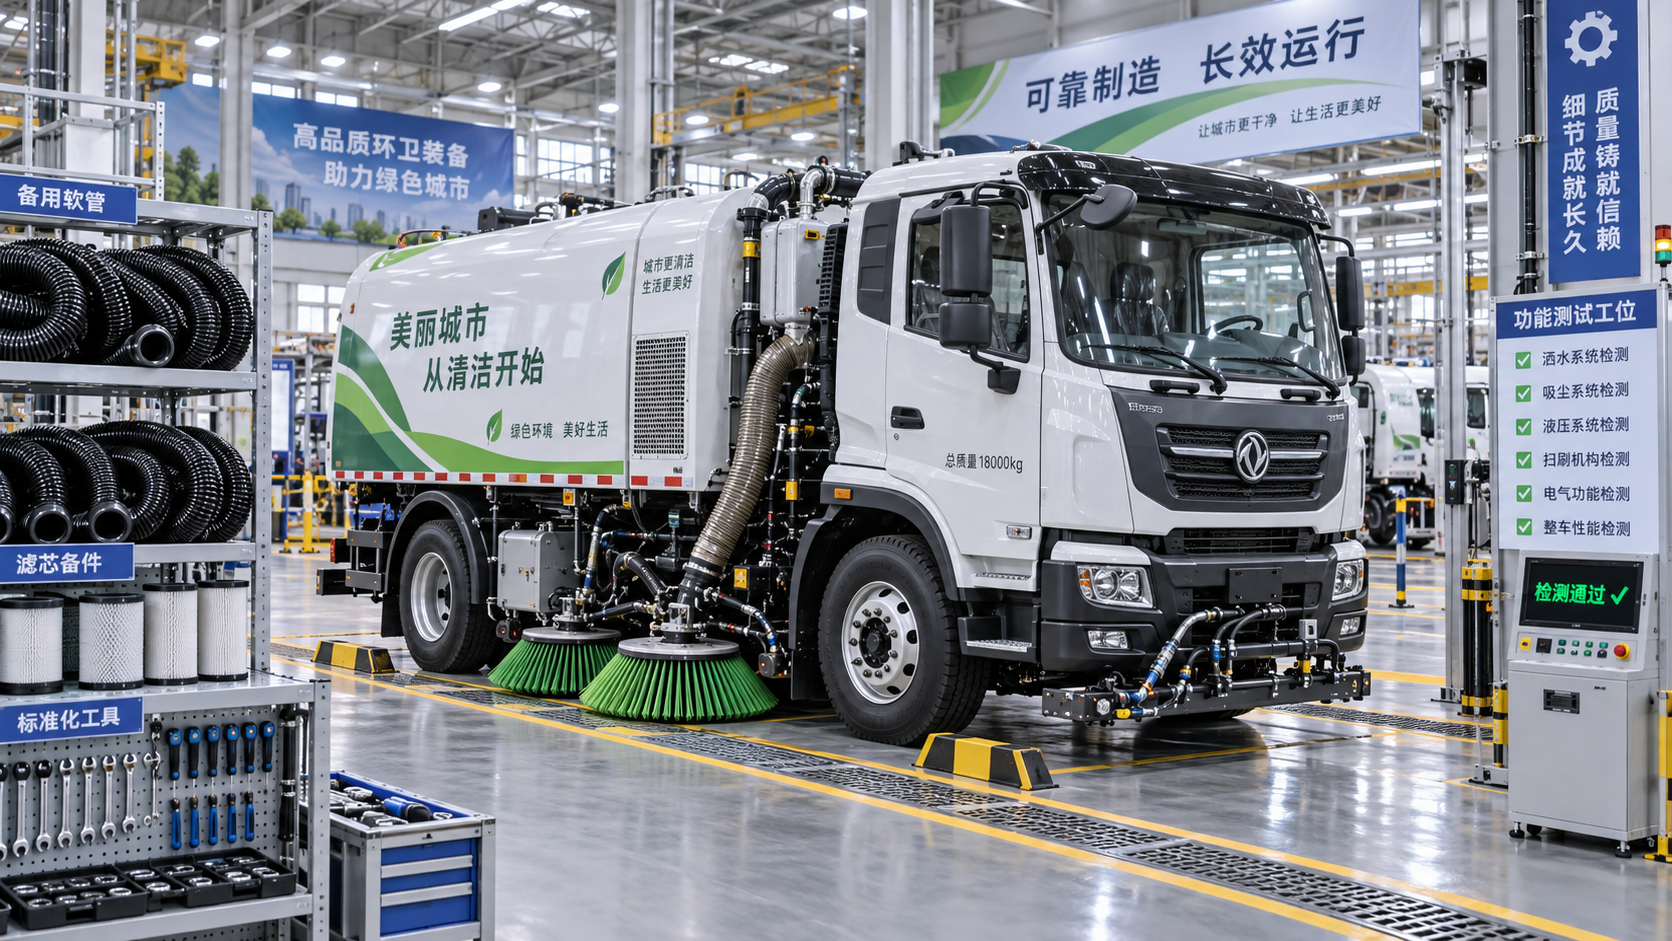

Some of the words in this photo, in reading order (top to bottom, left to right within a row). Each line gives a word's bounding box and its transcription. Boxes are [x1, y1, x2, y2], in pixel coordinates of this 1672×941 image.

[1025, 55, 1161, 114] 可靠制造
[1200, 16, 1365, 84] 长效运行
[1198, 112, 1277, 138] 让城市更干净
[1290, 95, 1381, 124] 让生活更美好
[293, 122, 469, 168] 高品质环卫装备
[323, 160, 470, 201] 助力绿色城市
[1562, 93, 1587, 255] 细节成就长久
[1595, 87, 1621, 252] 质量铸就信赖
[17, 184, 106, 213] 备用软管
[641, 274, 693, 295] 生活更美好
[390, 302, 489, 351] 美丽城市
[1513, 299, 1637, 330] 功能测试工位
[423, 346, 545, 393] 从清洁开始
[1542, 346, 1629, 366] 洒水系统检测
[1542, 381, 1629, 400] 吸尘系统检测
[510, 422, 553, 439] 绿色环境
[563, 420, 608, 438] 美好生活
[1543, 416, 1630, 434] 液压系统检测
[1543, 450, 1630, 467] 扫刷机构检测
[1544, 486, 1630, 502] 电气功能检测
[1543, 519, 1631, 537] 整车性能检测
[16, 552, 102, 575] 滤芯备件
[1534, 582, 1606, 605] 检测通过
[17, 706, 120, 734] 标准化工具
